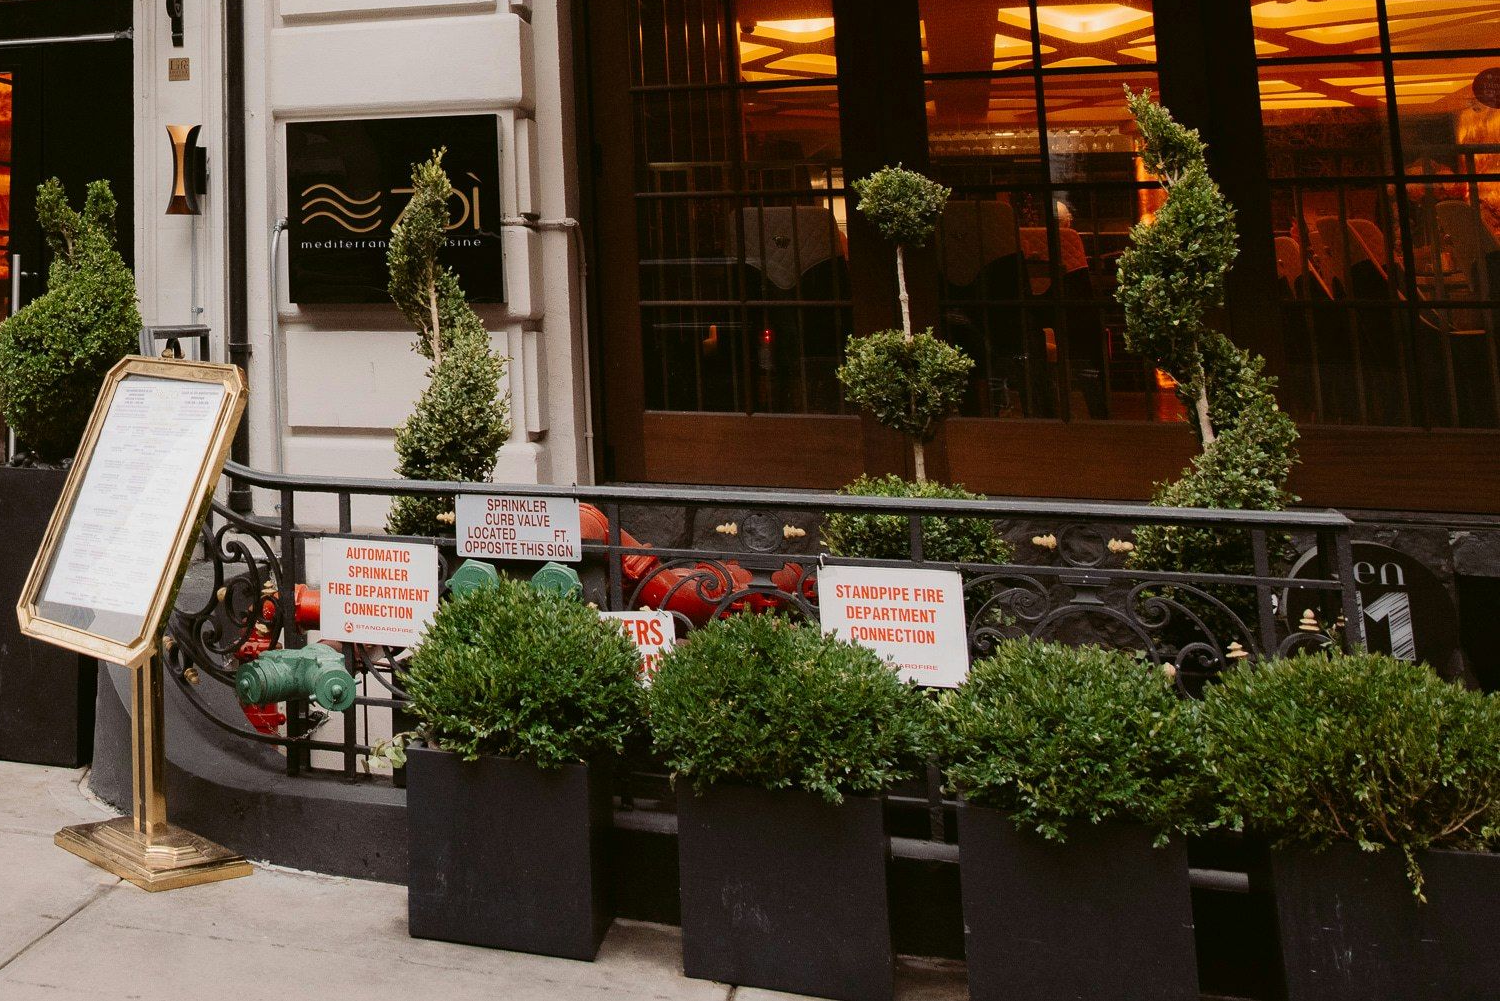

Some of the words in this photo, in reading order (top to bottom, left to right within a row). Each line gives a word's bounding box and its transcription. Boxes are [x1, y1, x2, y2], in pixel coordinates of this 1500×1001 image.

[487, 498, 547, 513] SPRINKLER
[485, 513, 515, 526] CURB
[517, 514, 550, 527] VALVE
[467, 526, 516, 540] LOCATED
[554, 530, 570, 542] FT.
[346, 547, 411, 563] AUTOMATIC
[465, 541, 518, 555] OPPOSITE
[520, 542, 545, 556] THIS
[547, 544, 574, 557] SIGN
[348, 565, 408, 581] SPRINKLER
[328, 582, 352, 596] FIRE
[355, 584, 430, 602] DEPARTMENT
[836, 584, 909, 602] STANDPIPE
[913, 588, 945, 604] FIRE
[344, 601, 413, 619] CONNECTION
[846, 605, 937, 624] DEPARTMENT
[850, 626, 936, 645] CONNECTION
